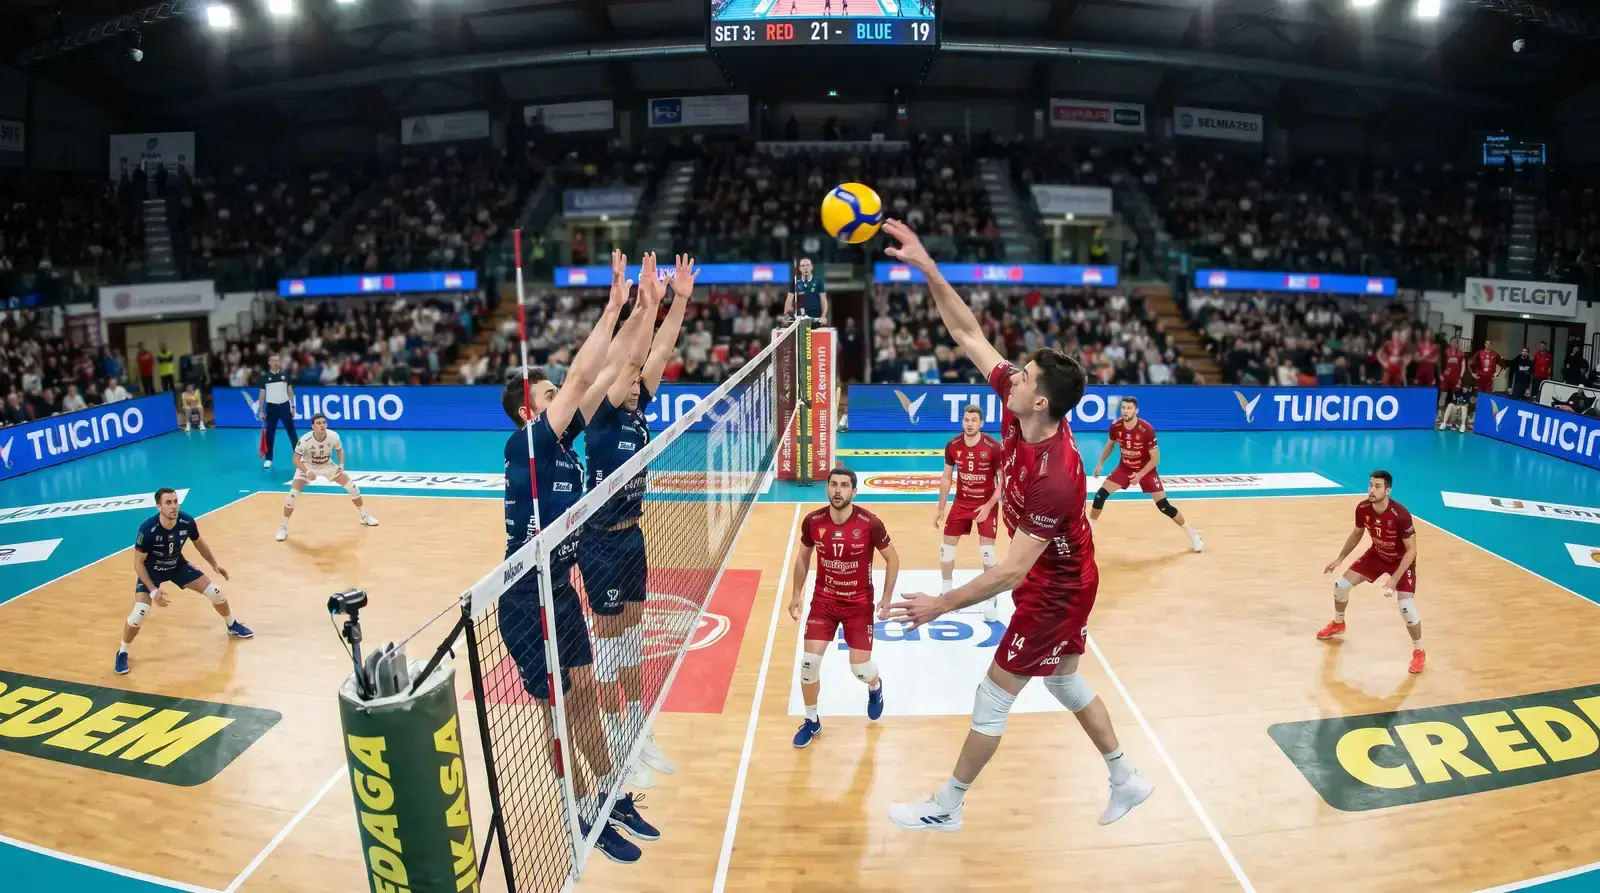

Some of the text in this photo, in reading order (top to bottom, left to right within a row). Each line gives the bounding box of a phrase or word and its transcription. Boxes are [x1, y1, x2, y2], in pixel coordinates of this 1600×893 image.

[715, 26, 739, 42] SET
[743, 25, 755, 41] 3:
[766, 23, 794, 40] RED
[810, 21, 829, 41] 21
[856, 23, 892, 40] BLUE
[911, 22, 930, 41] 19
[291, 393, 404, 421] UICINO
[968, 461, 974, 471] 9
[832, 543, 844, 557] 17
[1011, 632, 1026, 650] 14
[0, 681, 236, 767] EDEM
[1335, 696, 1600, 789] CRED
[433, 714, 480, 893] IKASA
